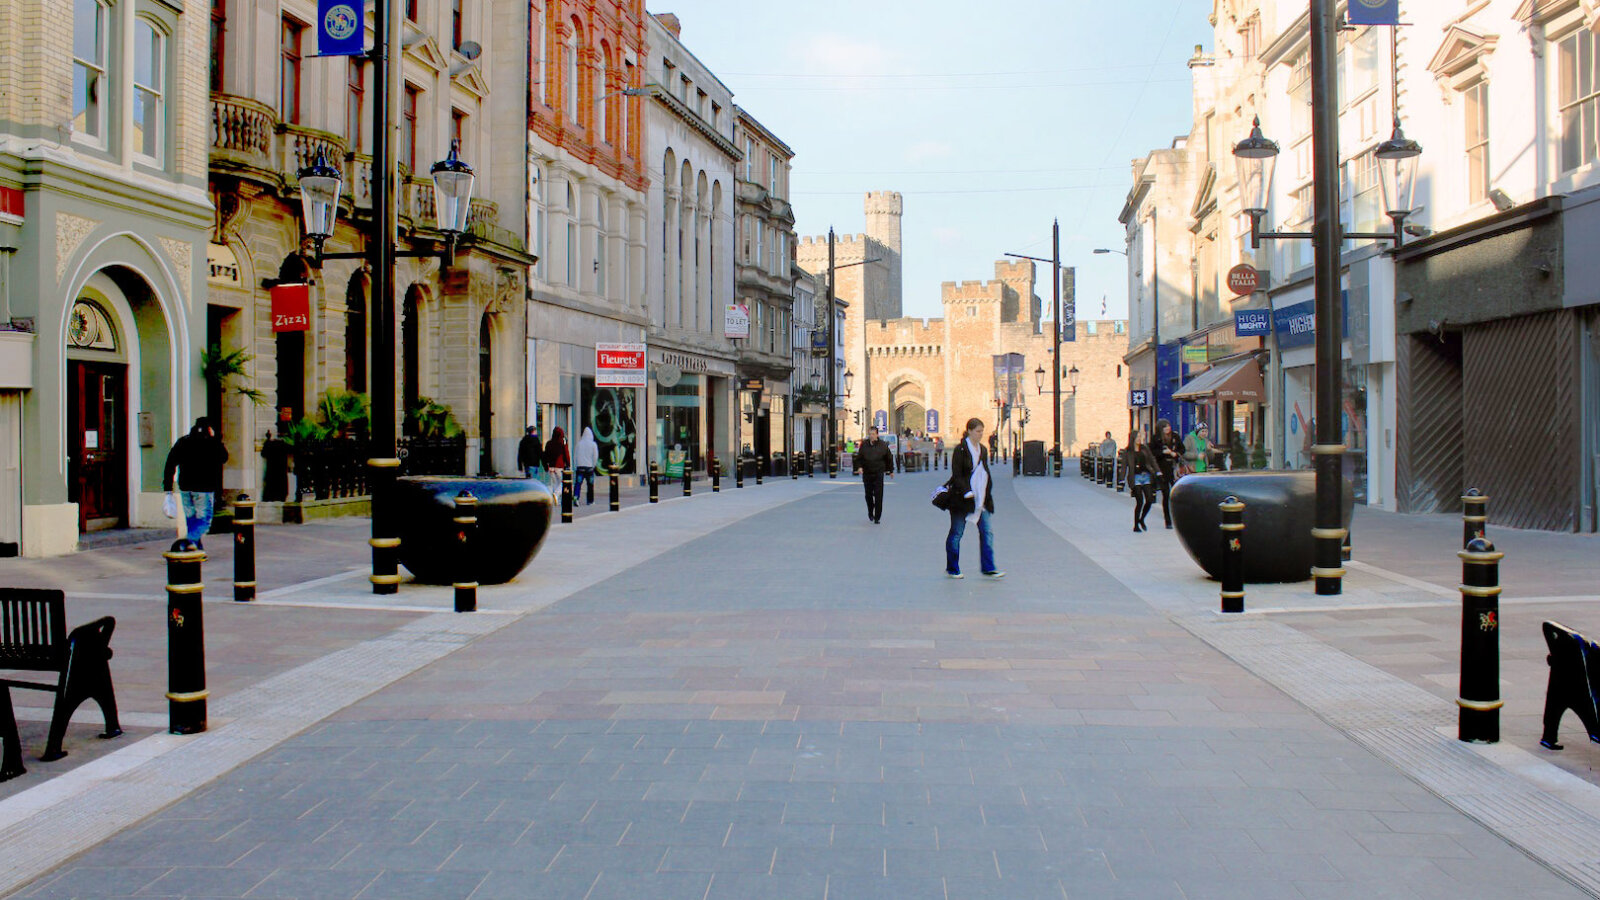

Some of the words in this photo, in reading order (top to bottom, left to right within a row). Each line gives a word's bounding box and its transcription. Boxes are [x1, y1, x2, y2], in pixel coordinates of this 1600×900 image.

[207, 258, 238, 281] izzi
[275, 314, 307, 326] Zizzi
[1238, 313, 1265, 322] HIGH
[600, 353, 638, 365] Fleurets
